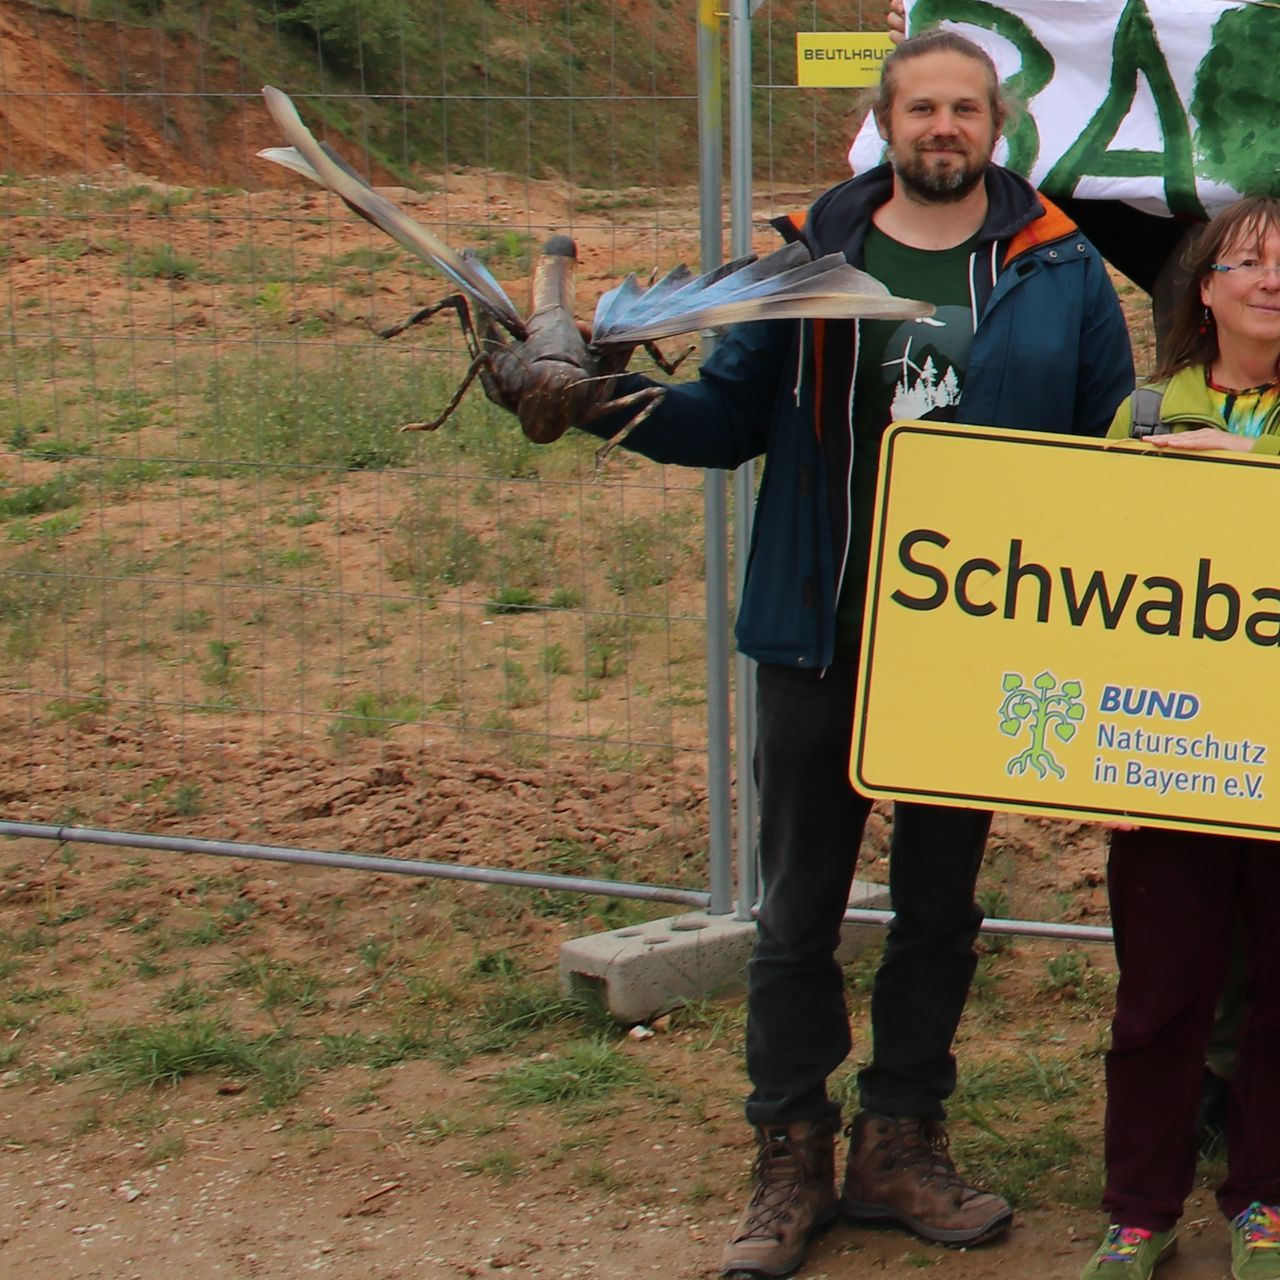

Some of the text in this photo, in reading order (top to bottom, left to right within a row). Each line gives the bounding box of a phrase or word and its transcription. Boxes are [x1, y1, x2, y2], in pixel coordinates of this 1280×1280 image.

[1099, 686, 1200, 721] BUND
[1097, 723, 1266, 764] Naturschutz
[1094, 757, 1264, 799] in Bayern e.V.
